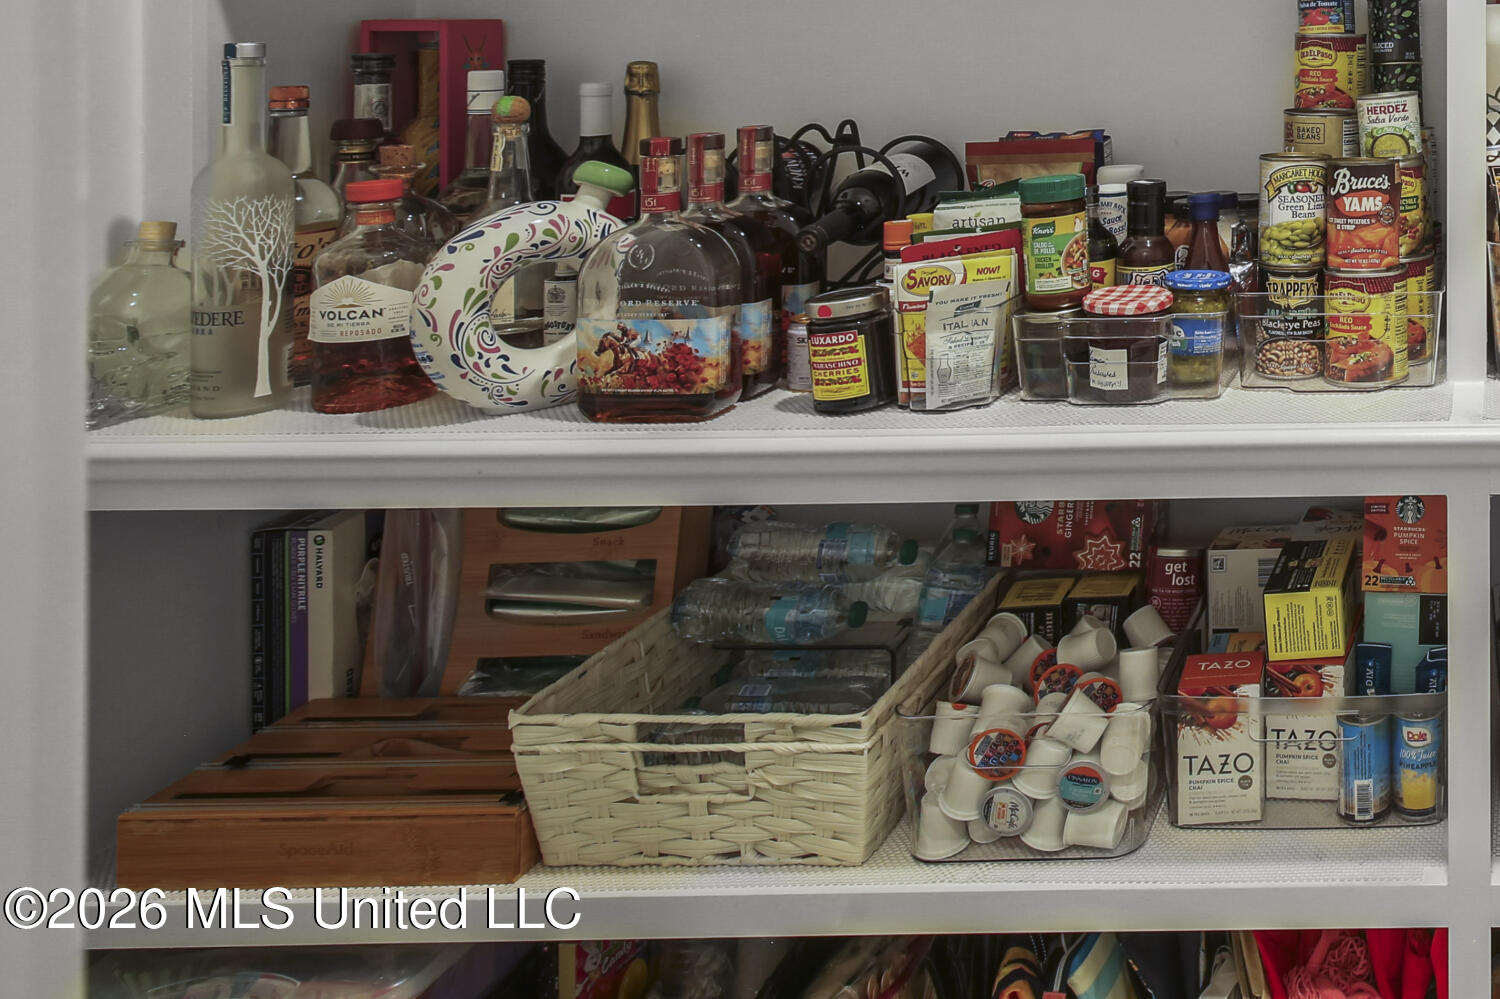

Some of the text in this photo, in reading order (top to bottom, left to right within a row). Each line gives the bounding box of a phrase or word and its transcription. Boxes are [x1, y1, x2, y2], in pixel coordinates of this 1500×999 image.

[1367, 104, 1408, 115] HERDEZ
[1367, 115, 1409, 125] Salsa Verde
[1330, 168, 1391, 196] Bruce's
[1278, 203, 1305, 211] Green
[1343, 196, 1383, 212] YAMS
[952, 212, 1006, 229] artisan
[1102, 215, 1123, 225] Sauce
[1291, 210, 1316, 219] Beans
[1032, 225, 1054, 235] Knorr
[977, 266, 1000, 275] NOW!
[906, 269, 951, 289] SAVORY
[1266, 282, 1319, 295] TRAPPEY'S
[320, 308, 384, 321] VOLCAN
[340, 328, 382, 337] REPOSADO
[811, 333, 854, 346] LUXARDO
[814, 369, 860, 377] CHERRIES
[297, 537, 306, 573] PURPLE
[1129, 552, 1141, 568] 22
[1165, 562, 1188, 575] get
[1172, 574, 1195, 586] lost
[1365, 575, 1379, 586] 22
[1197, 660, 1251, 671] TAZO
[1271, 728, 1337, 751] TAZO
[1407, 730, 1428, 742] Dole
[1182, 753, 1254, 776] TAZO
